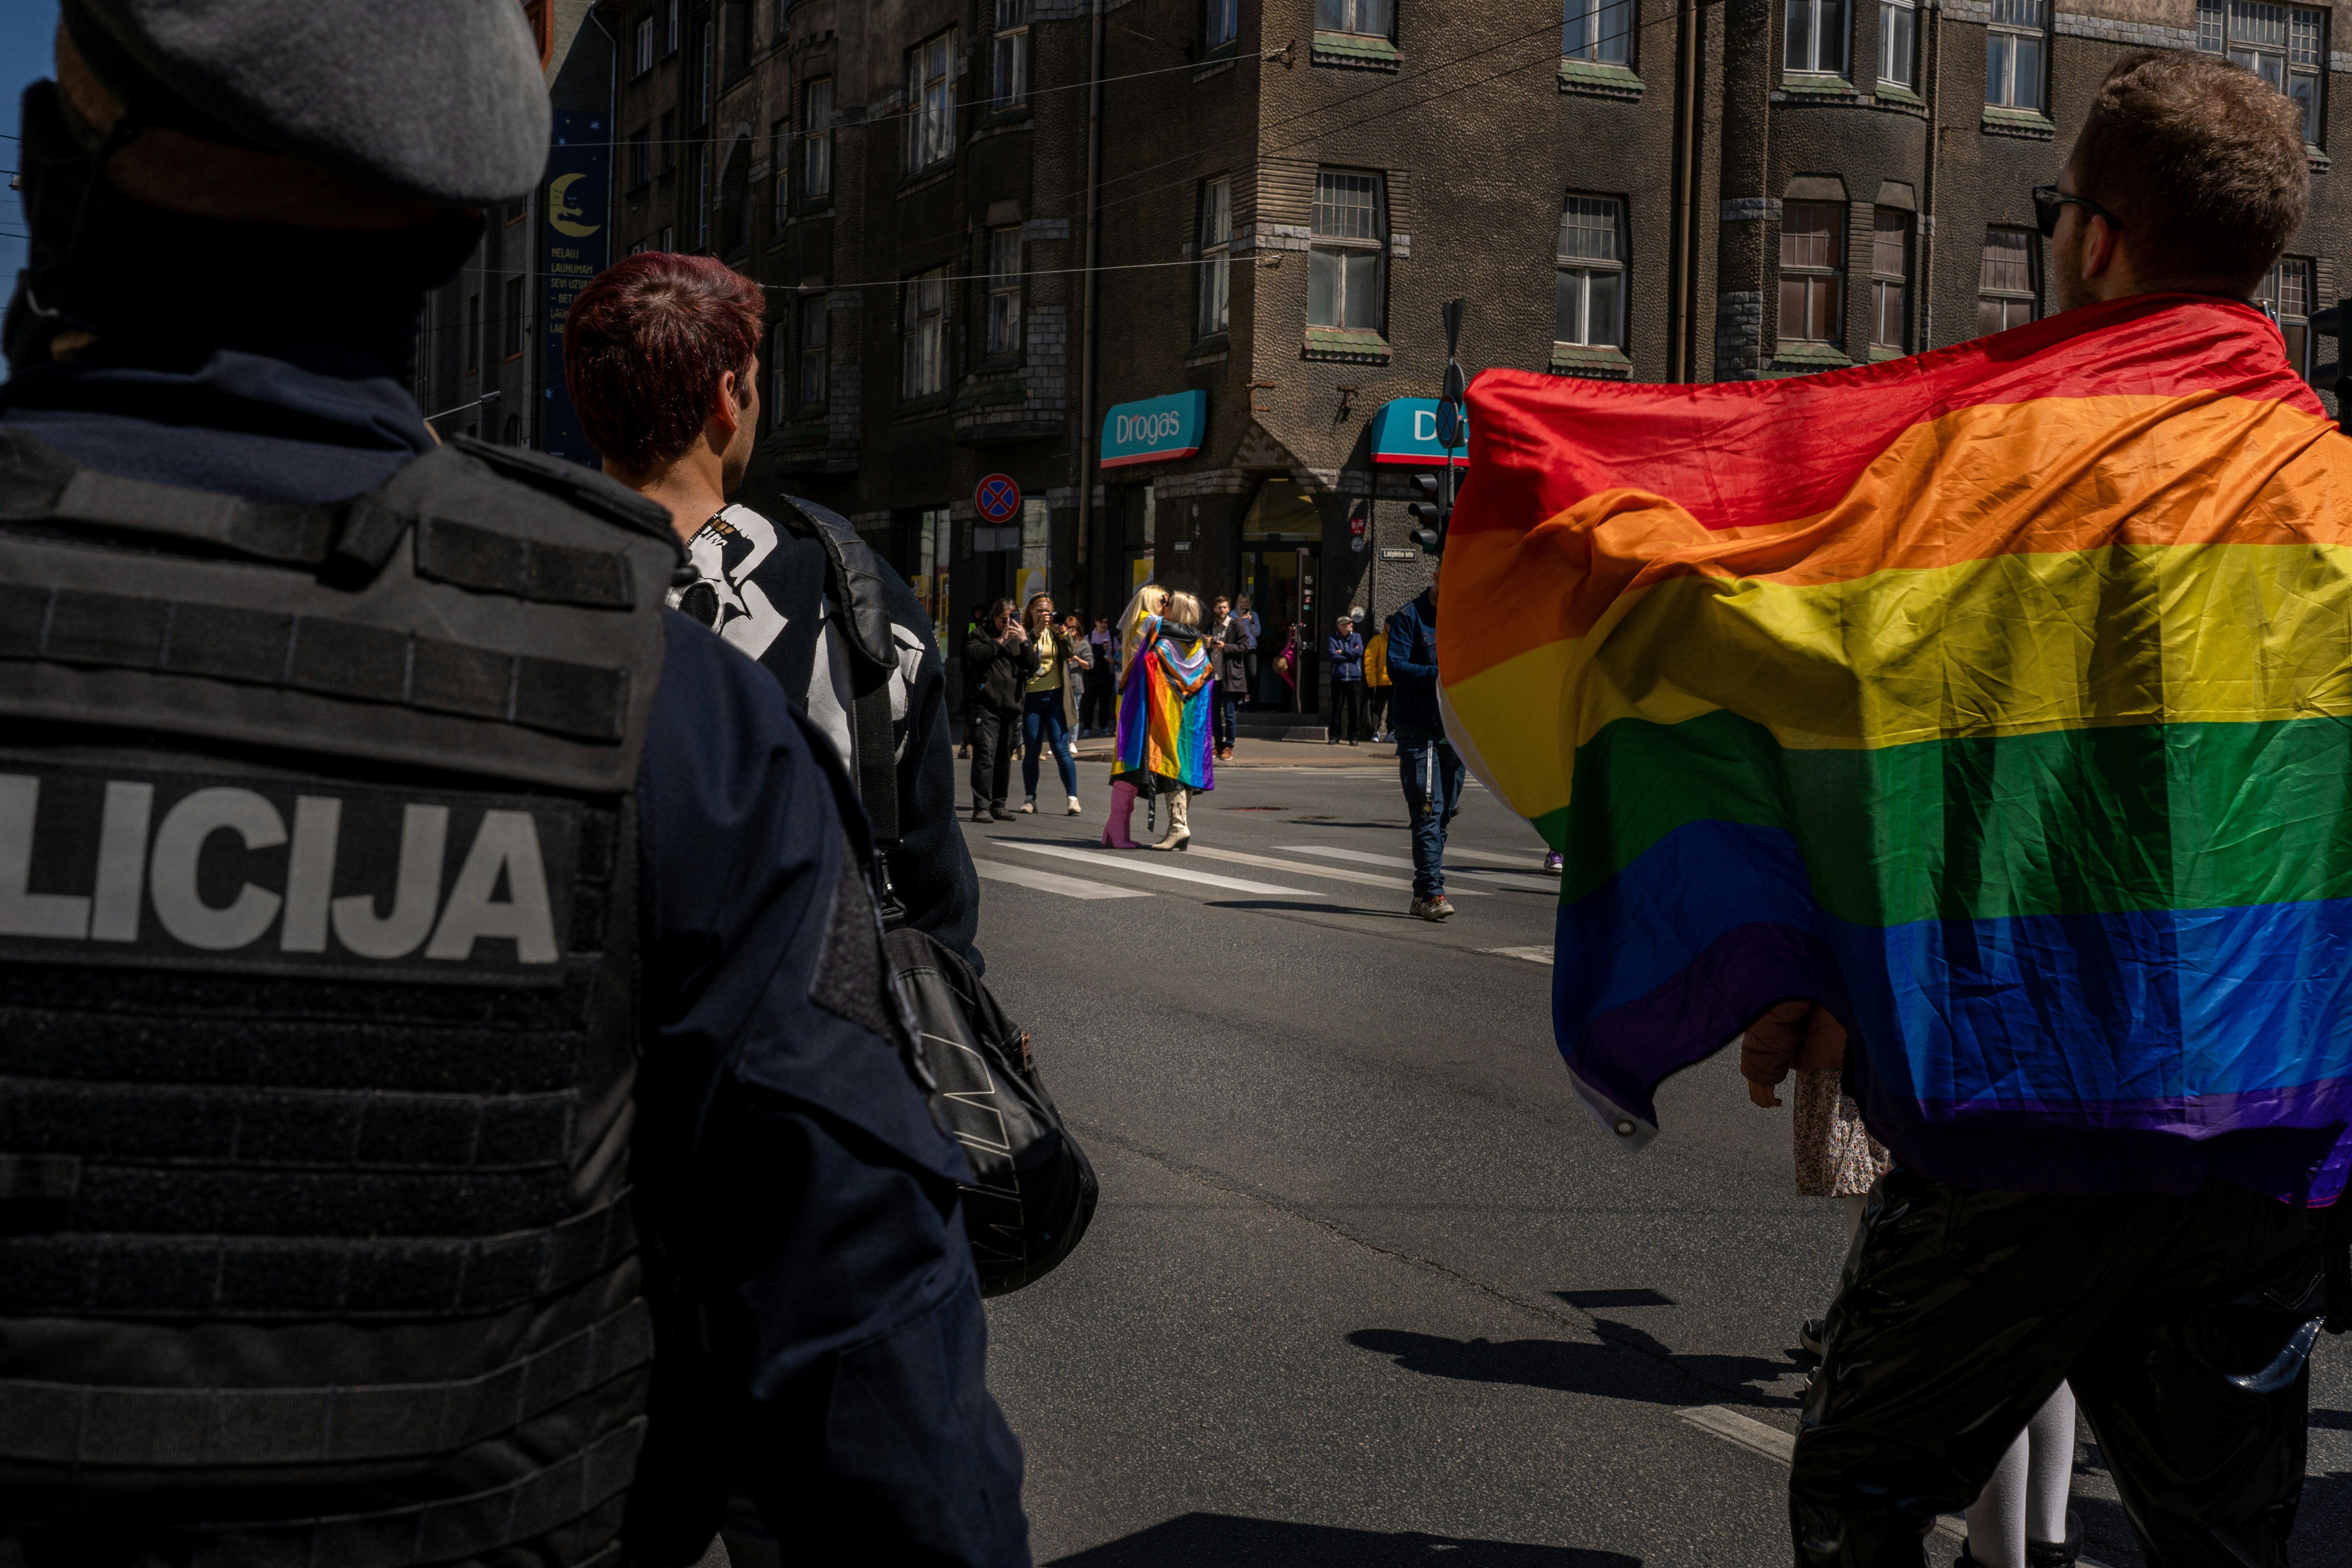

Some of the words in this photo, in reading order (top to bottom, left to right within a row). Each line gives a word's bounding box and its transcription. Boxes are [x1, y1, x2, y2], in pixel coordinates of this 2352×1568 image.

[552, 248, 579, 260] NEĻAUJ
[551, 278, 567, 288] SEVI
[558, 293, 573, 303] BET
[1117, 411, 1180, 445] Drogas
